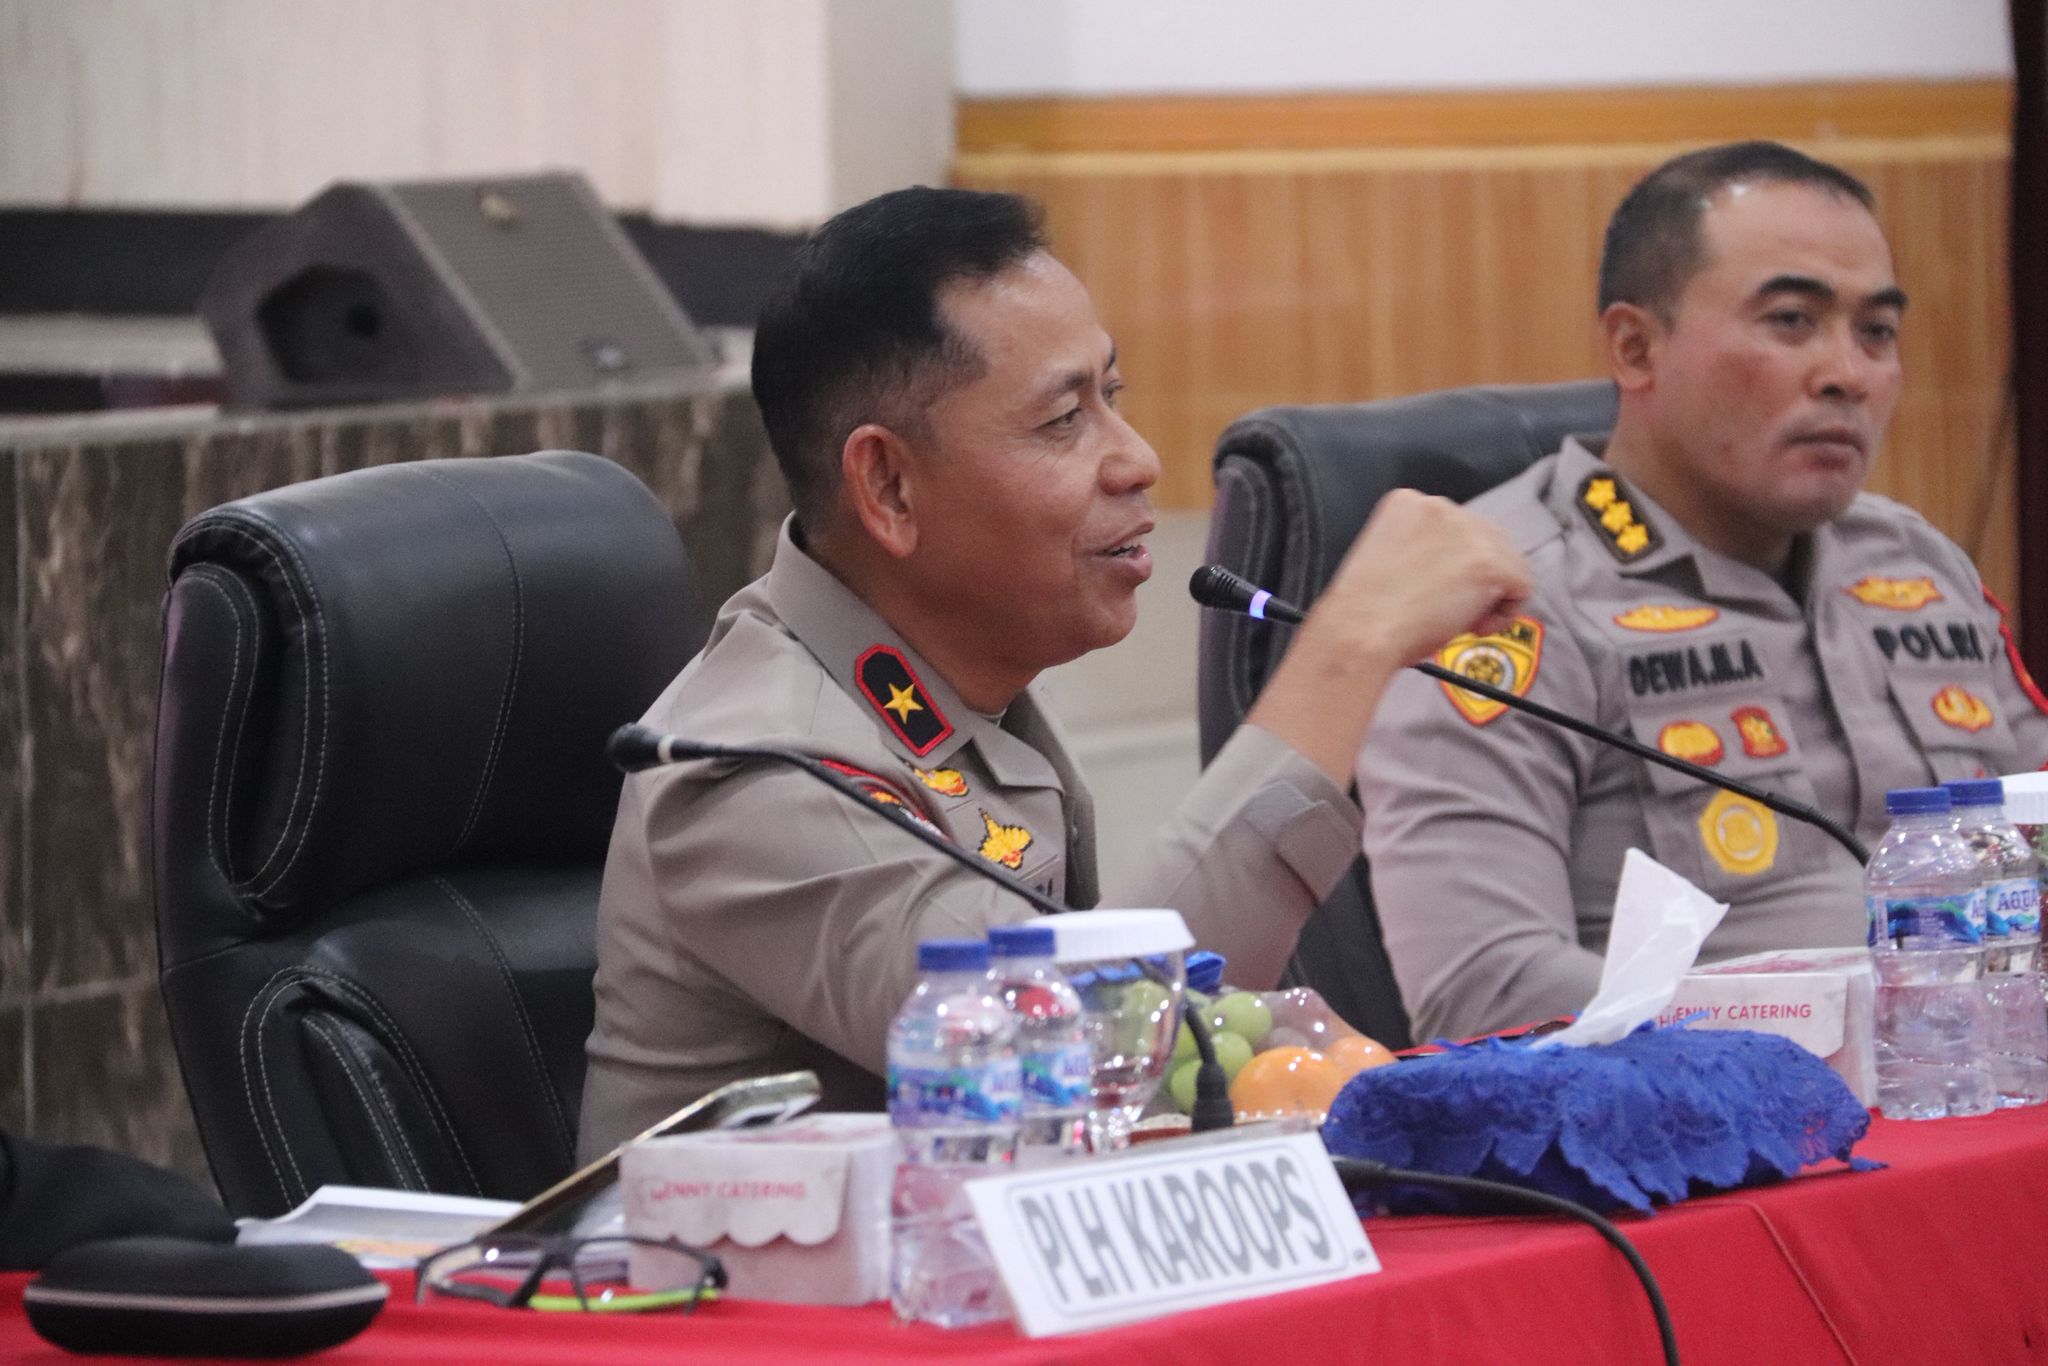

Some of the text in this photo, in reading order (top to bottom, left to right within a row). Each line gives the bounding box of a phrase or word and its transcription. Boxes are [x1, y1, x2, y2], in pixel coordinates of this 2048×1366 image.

[1872, 621, 1984, 661] POLRI
[1727, 1004, 1812, 1020] CATERING
[1016, 1155, 1331, 1302] PLH KAROOPS
